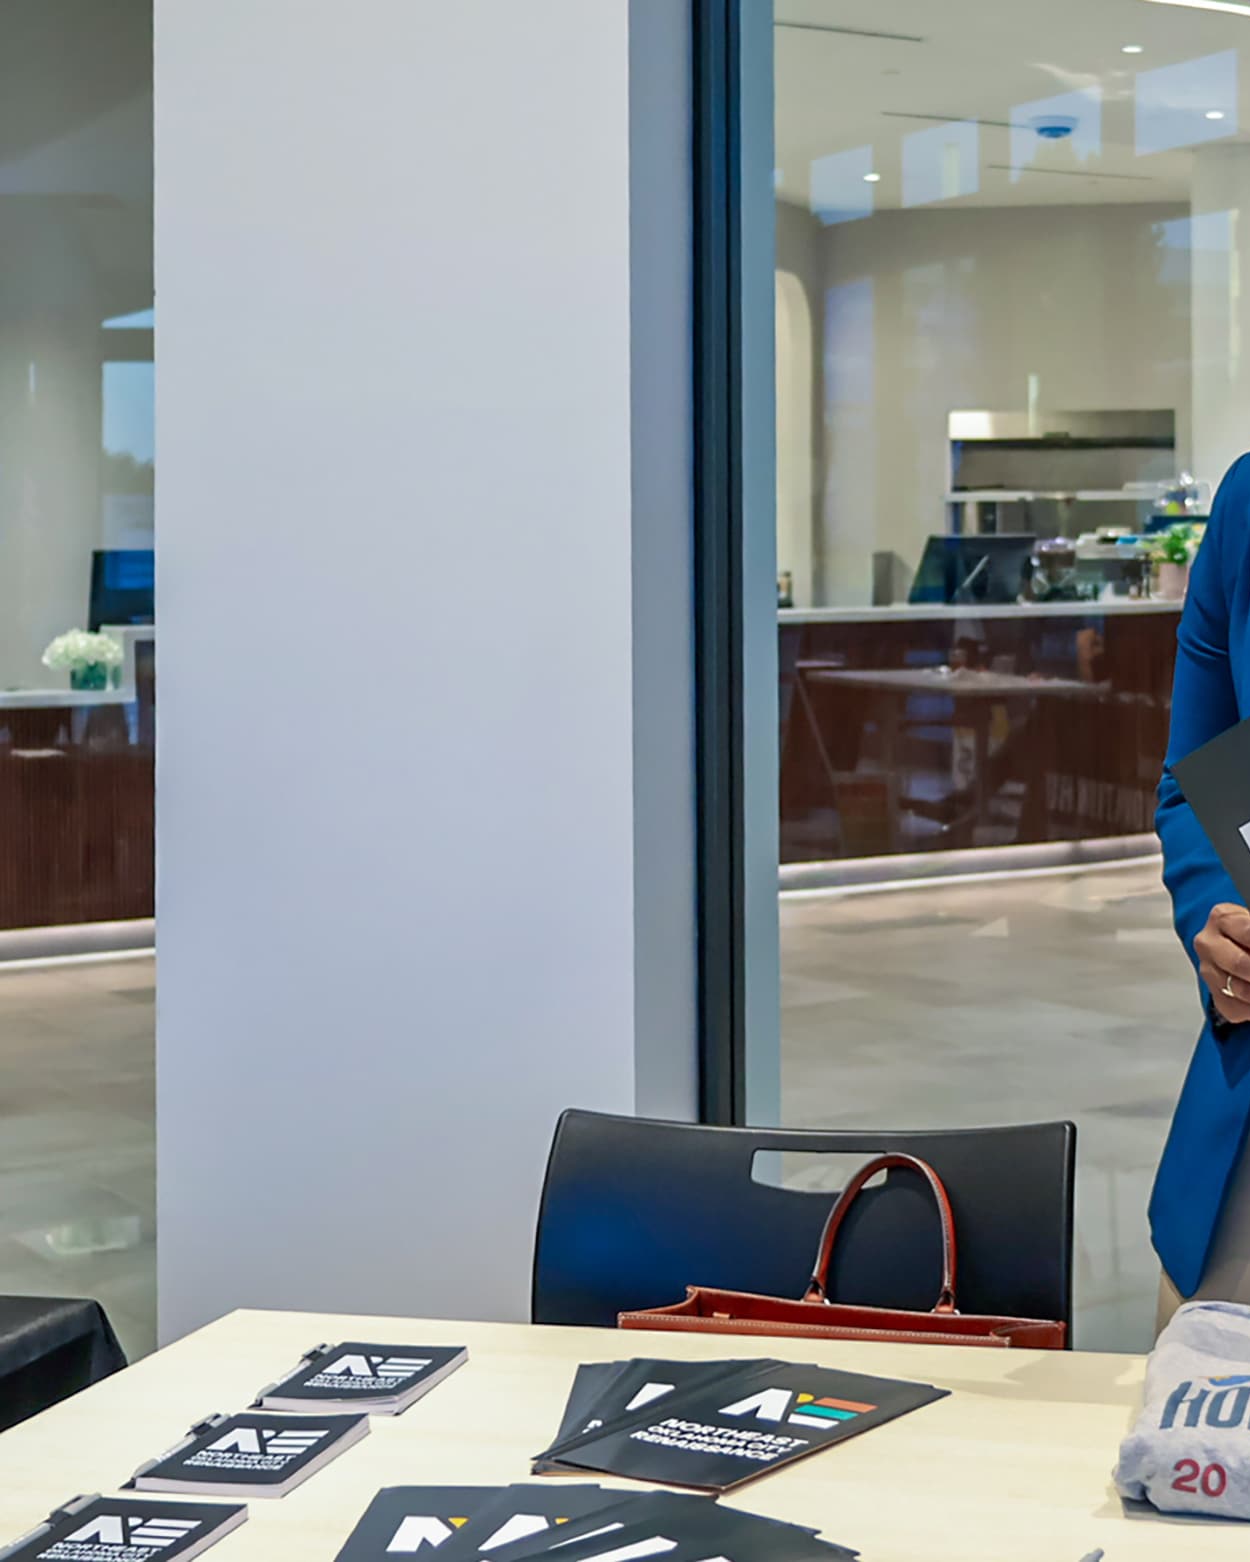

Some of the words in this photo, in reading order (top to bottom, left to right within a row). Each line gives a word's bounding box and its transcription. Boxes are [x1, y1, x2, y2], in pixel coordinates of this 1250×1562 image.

[629, 1430, 780, 1461] RENAISSANCE
[647, 1425, 746, 1447] OKLAHOMA
[747, 1442, 793, 1453] CITY
[659, 1417, 809, 1448] NORTHEAST
[1171, 1458, 1227, 1497] 20
